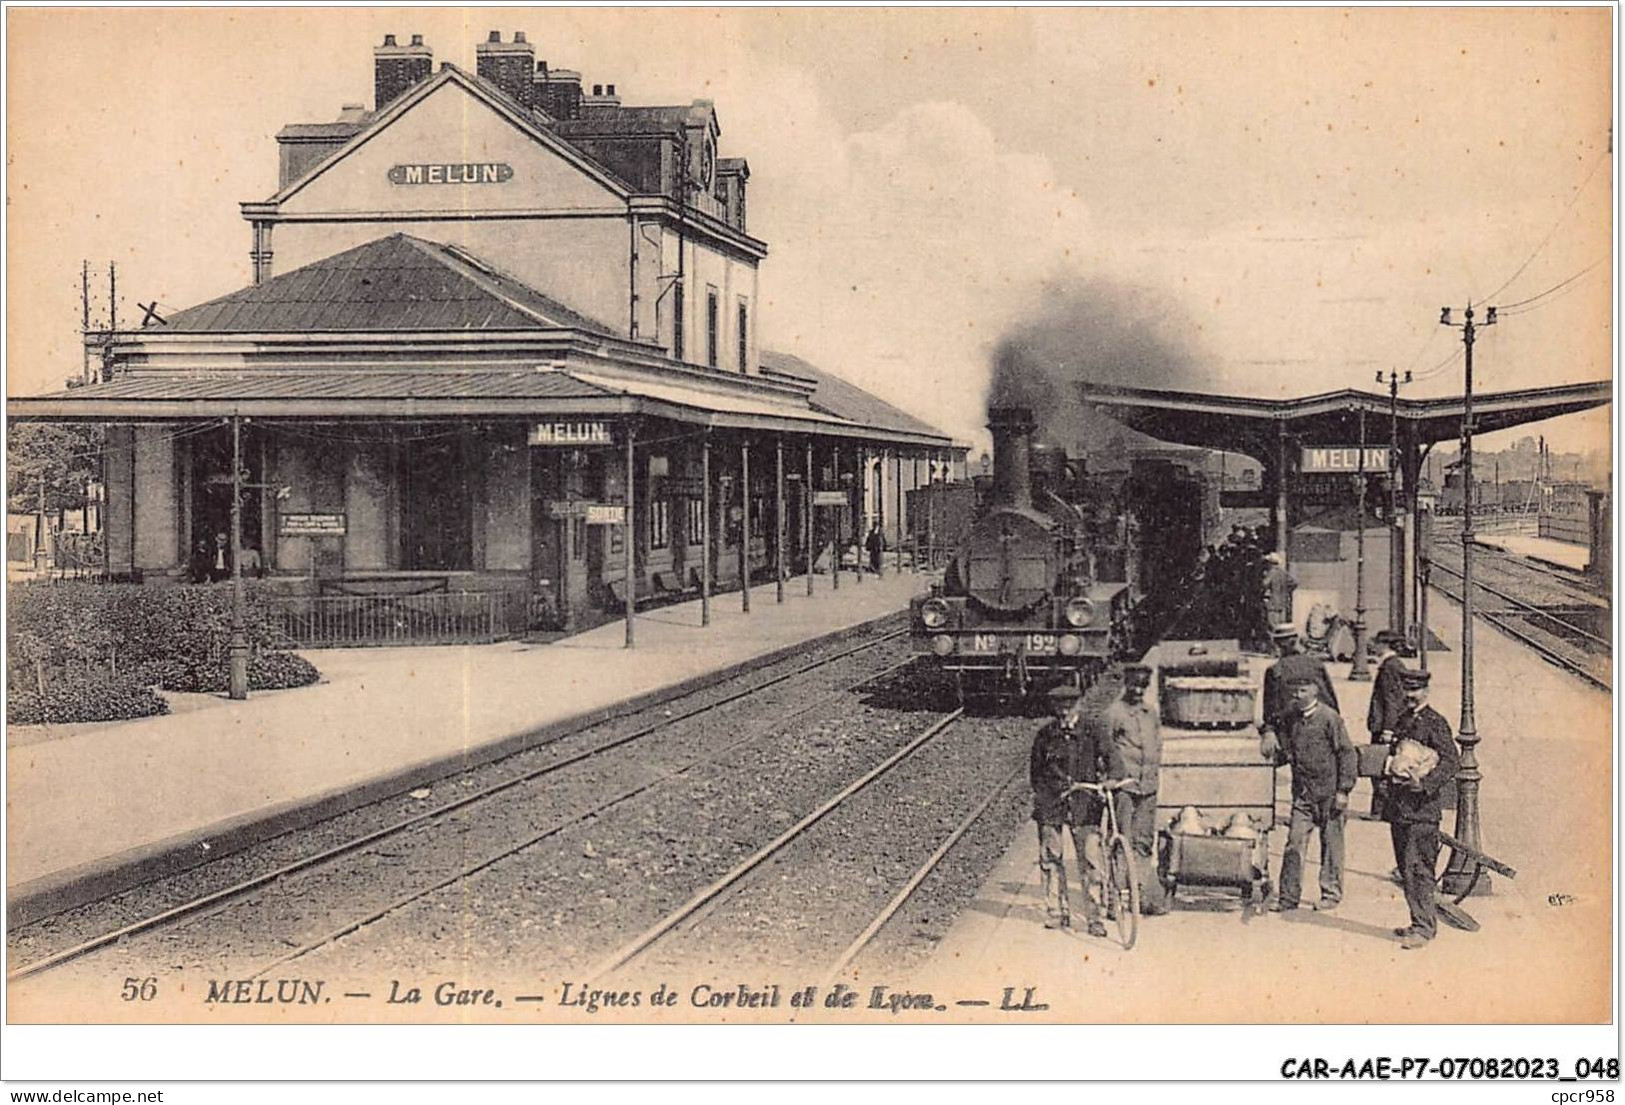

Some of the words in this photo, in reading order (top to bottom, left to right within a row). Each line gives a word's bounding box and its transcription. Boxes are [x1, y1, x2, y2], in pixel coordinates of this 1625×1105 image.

[405, 165, 498, 184] MELUN
[537, 422, 604, 442] MELUN
[1311, 448, 1386, 469] MELUN
